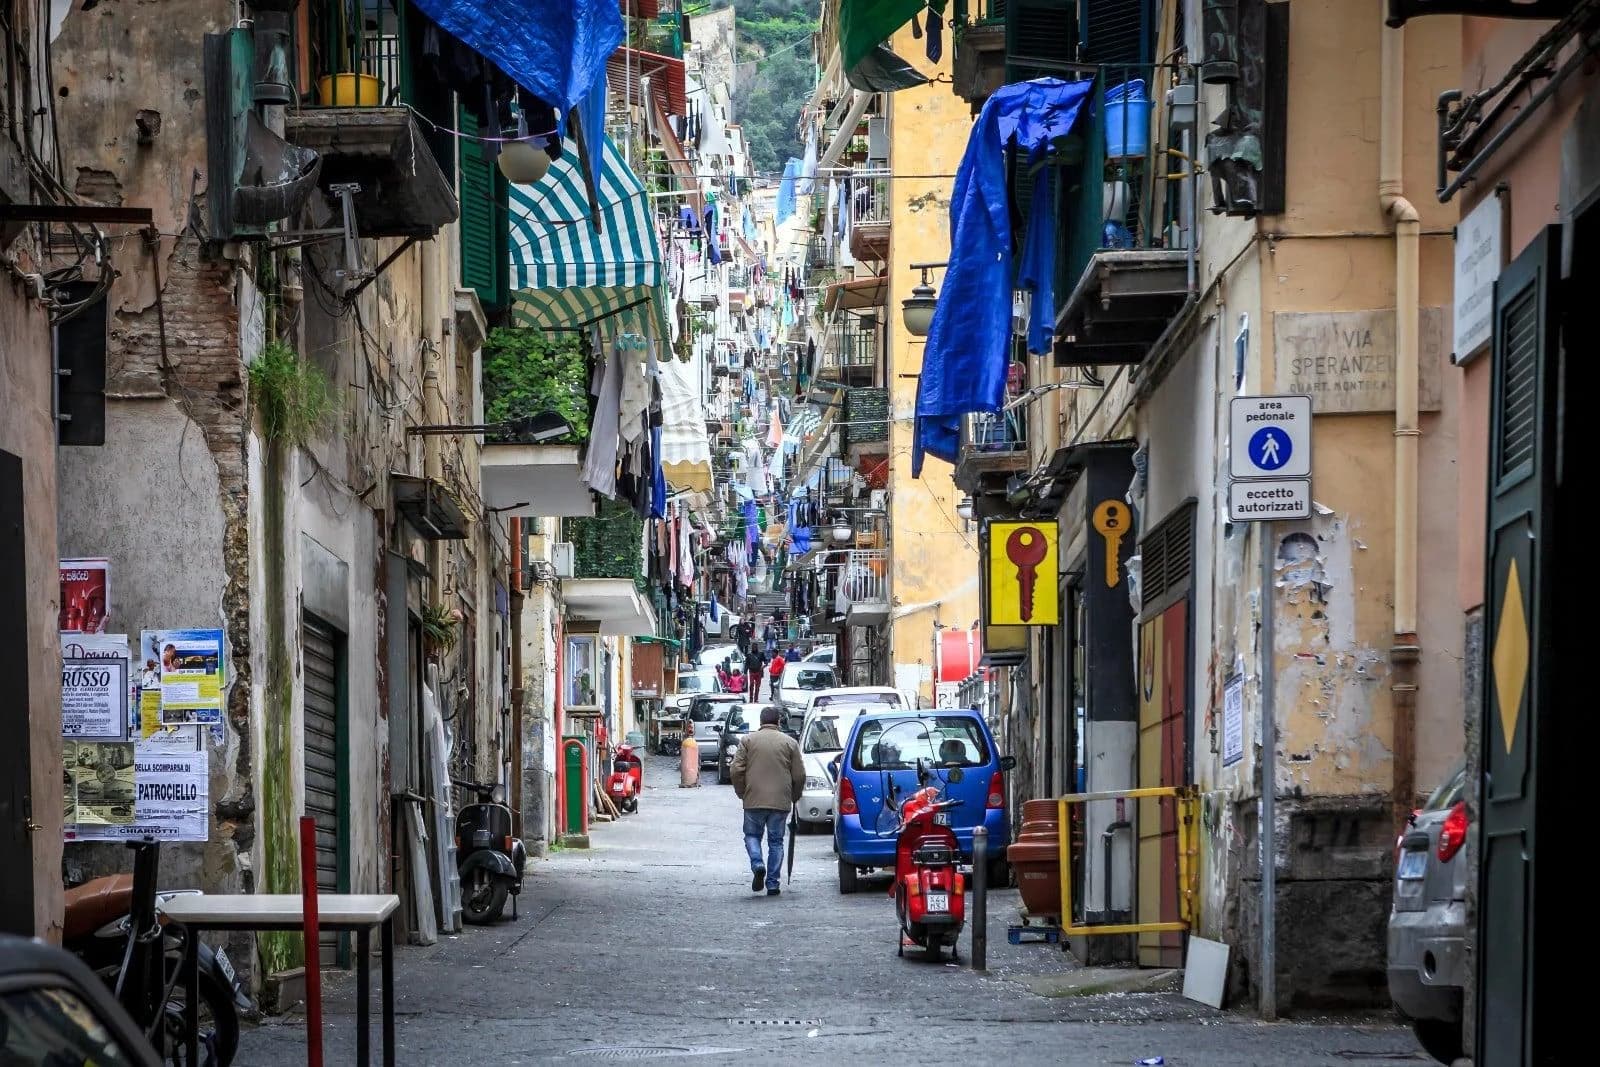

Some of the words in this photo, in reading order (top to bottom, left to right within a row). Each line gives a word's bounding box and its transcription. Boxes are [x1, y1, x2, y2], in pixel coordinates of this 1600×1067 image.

[1343, 329, 1374, 348] VIA
[1258, 402, 1283, 410] area
[1246, 411, 1295, 422] pedonale
[1246, 488, 1294, 499] eccetto
[1237, 500, 1304, 513] autorizzati
[62, 671, 111, 687] RUSSO
[135, 763, 151, 772] DELLA
[152, 763, 184, 773] SCOMPARSA
[138, 783, 197, 801] PATROCIELLO
